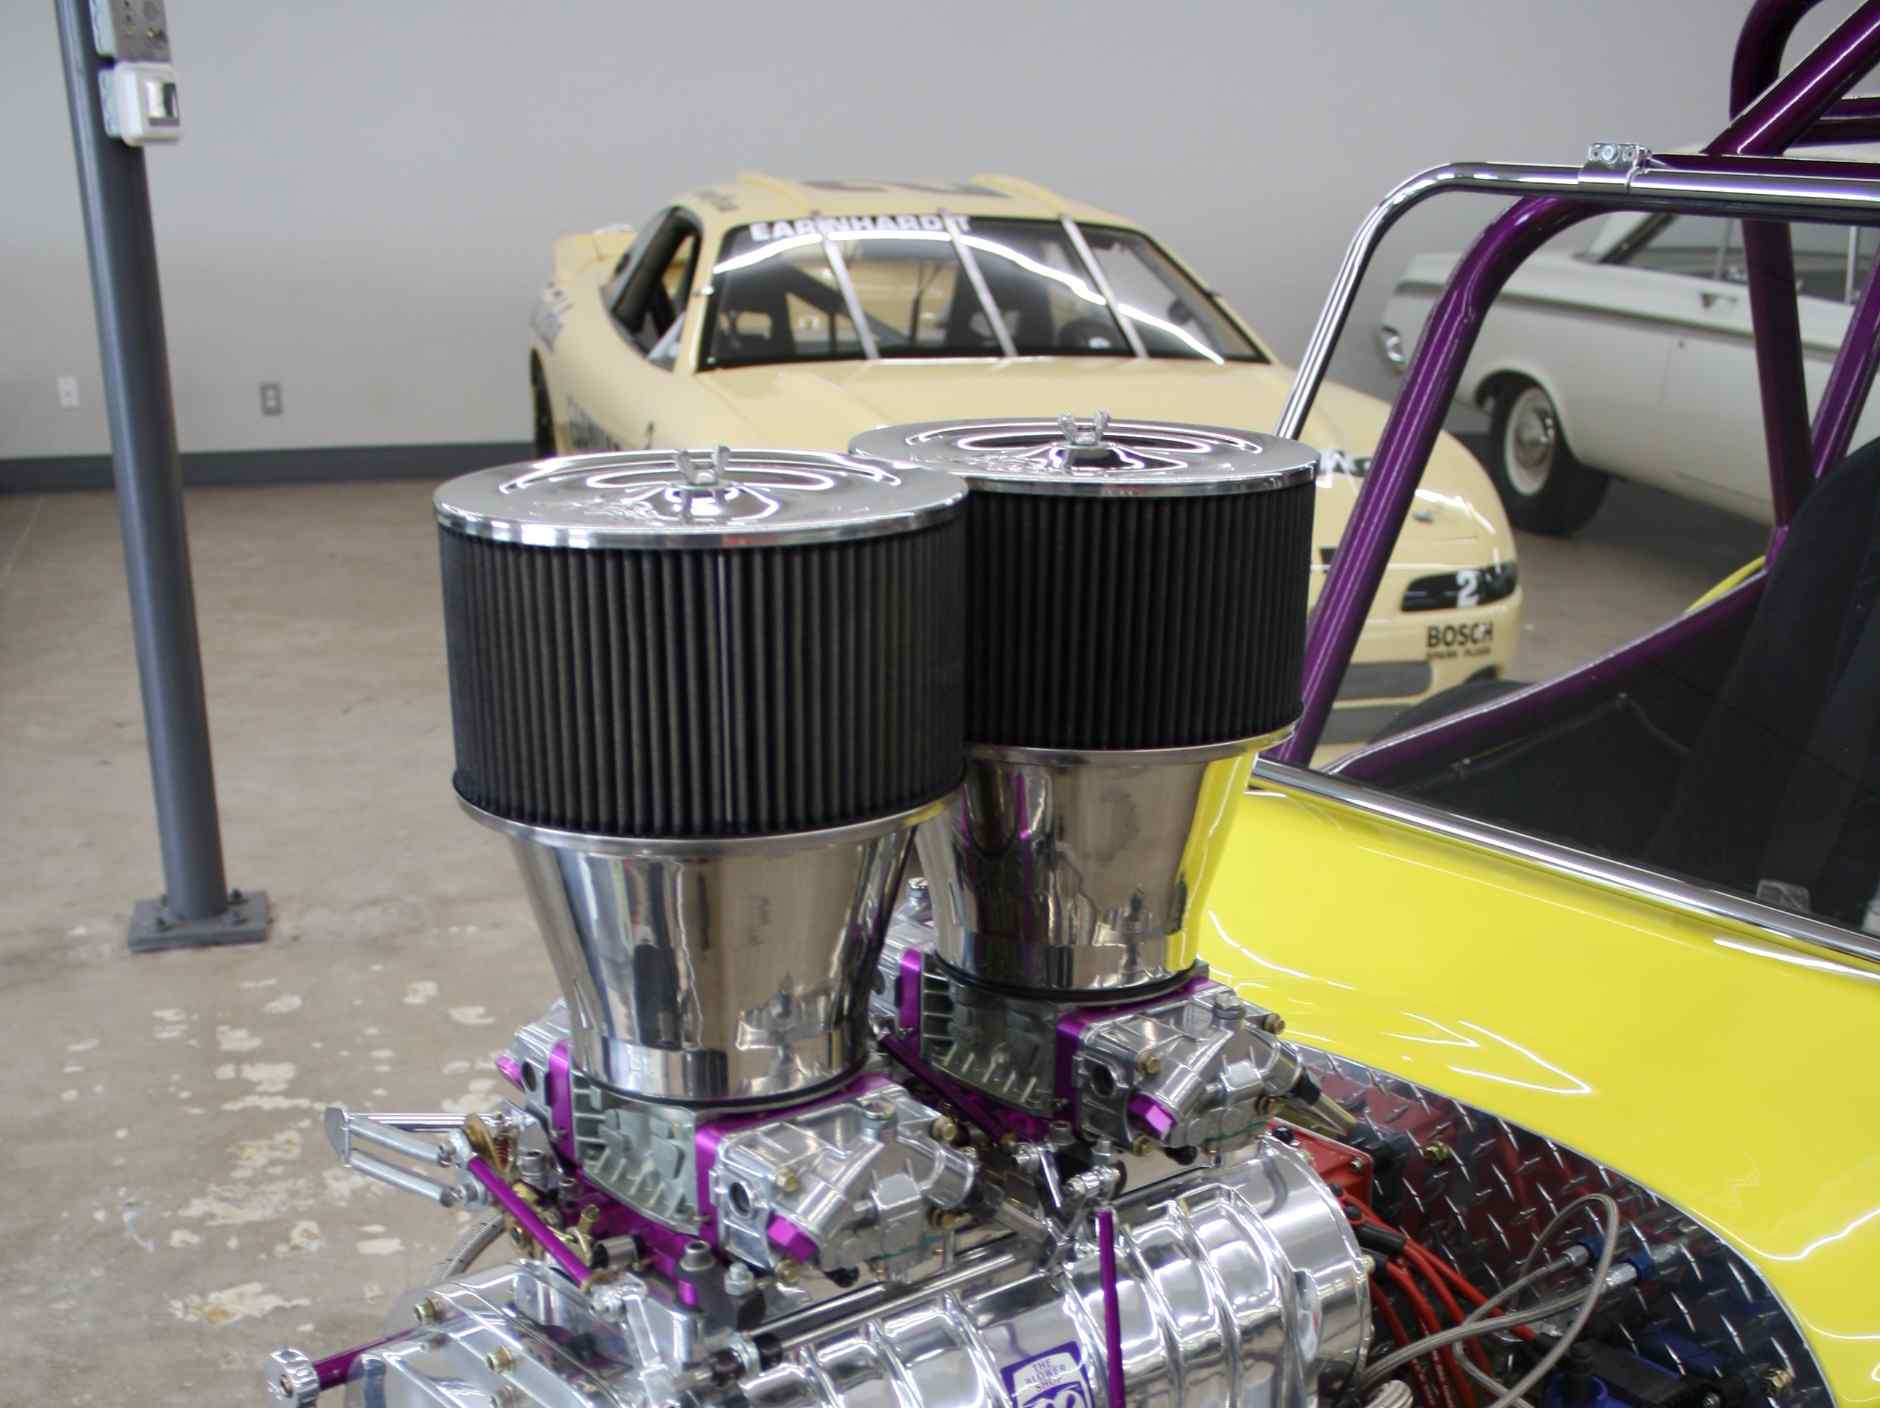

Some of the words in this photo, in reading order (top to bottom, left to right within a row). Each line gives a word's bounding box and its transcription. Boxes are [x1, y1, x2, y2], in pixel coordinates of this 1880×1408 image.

[1456, 569, 1479, 608] 2
[1427, 622, 1493, 648] BOSCH
[1031, 1360, 1051, 1373] THE
